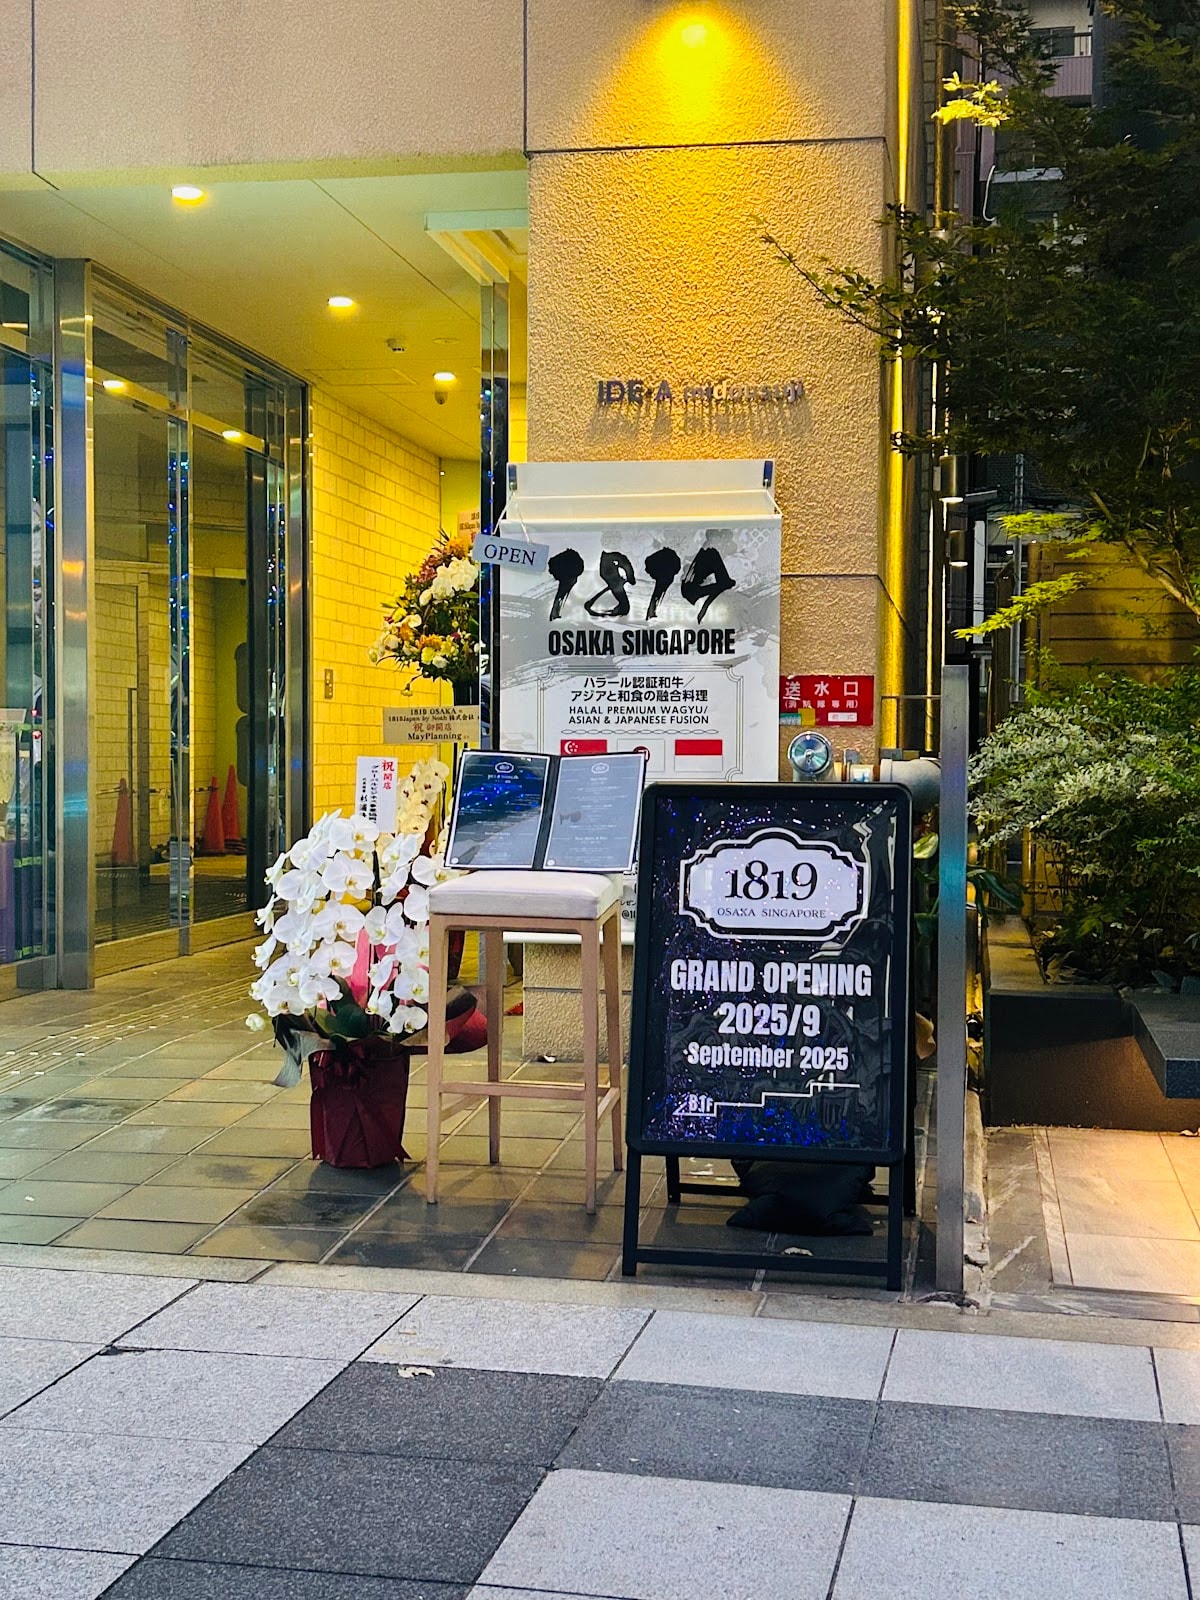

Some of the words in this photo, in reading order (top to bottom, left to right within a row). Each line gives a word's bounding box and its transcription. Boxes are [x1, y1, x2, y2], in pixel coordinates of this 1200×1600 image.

[484, 544, 536, 566] OPEN
[548, 547, 736, 624] 1819
[549, 629, 615, 656] OSAKA
[622, 628, 736, 656] SINGAPORE
[571, 689, 709, 702] アジアと和食の融合料理
[783, 680, 859, 698] 送水口
[429, 707, 457, 715] OSAKA
[569, 706, 603, 714] HALAL
[607, 706, 656, 714] PREMIUM
[660, 705, 708, 715] WAGYU/
[413, 722, 424, 732] 祝
[569, 715, 600, 724] ASIAN
[604, 715, 611, 724] &
[614, 715, 666, 724] JAPANESE
[670, 715, 709, 724] FUSION
[407, 732, 462, 741] MayPlanning
[382, 759, 395, 772] 祝
[725, 860, 818, 901] 1819
[717, 907, 756, 917] OSAKA
[761, 909, 827, 918] SINGAPORE
[670, 959, 755, 993] GRAND
[763, 962, 872, 996] OPENING
[718, 1002, 821, 1037] 2025/9
[687, 1041, 795, 1068] September
[799, 1046, 849, 1071] 2025
